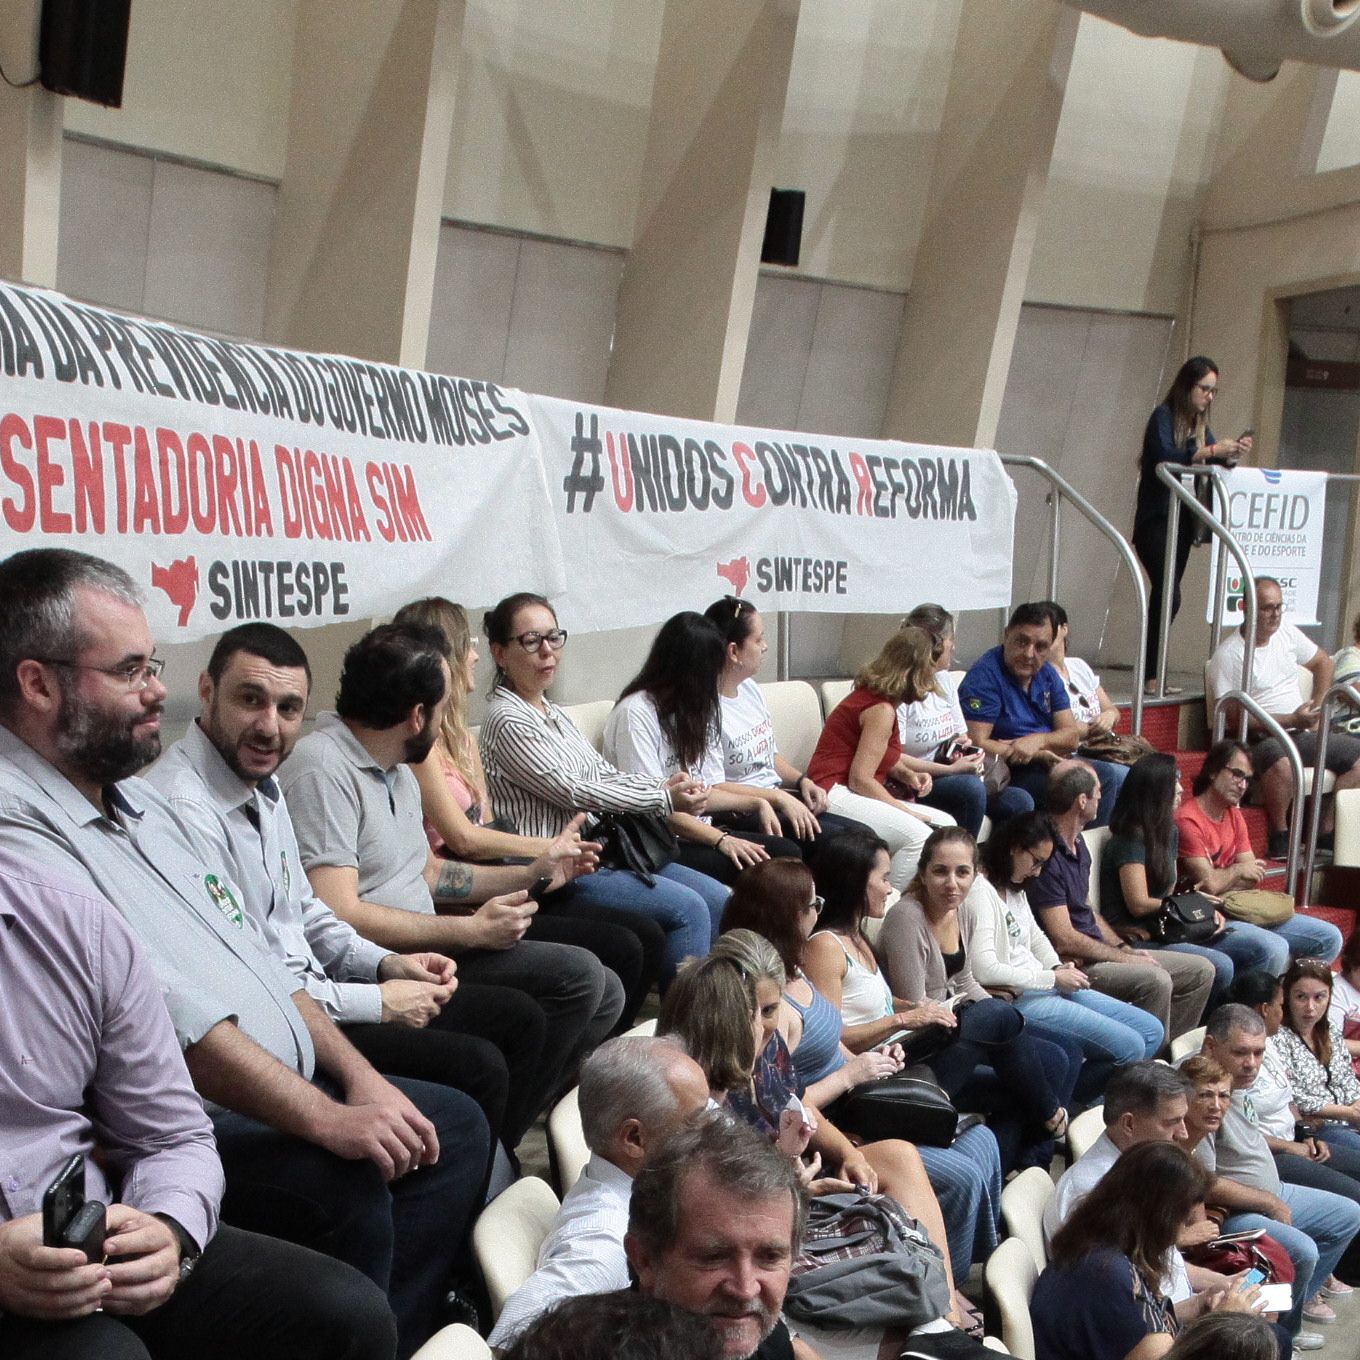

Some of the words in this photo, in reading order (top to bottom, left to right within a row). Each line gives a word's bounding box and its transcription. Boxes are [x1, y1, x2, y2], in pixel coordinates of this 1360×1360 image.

[8, 286, 105, 388] DA
[263, 348, 325, 428] DO
[306, 355, 428, 444] GOVERNO
[275, 443, 371, 543] DIGNA
[365, 460, 433, 543] SIM
[732, 441, 852, 515] CONTRA
[849, 452, 977, 521] REFORMA
[1229, 491, 1310, 530] CEFID
[1254, 532, 1264, 542] DE
[1272, 546, 1306, 557] ESPORTE
[208, 559, 349, 621] SINTESPE
[756, 556, 848, 594] SINTESPE
